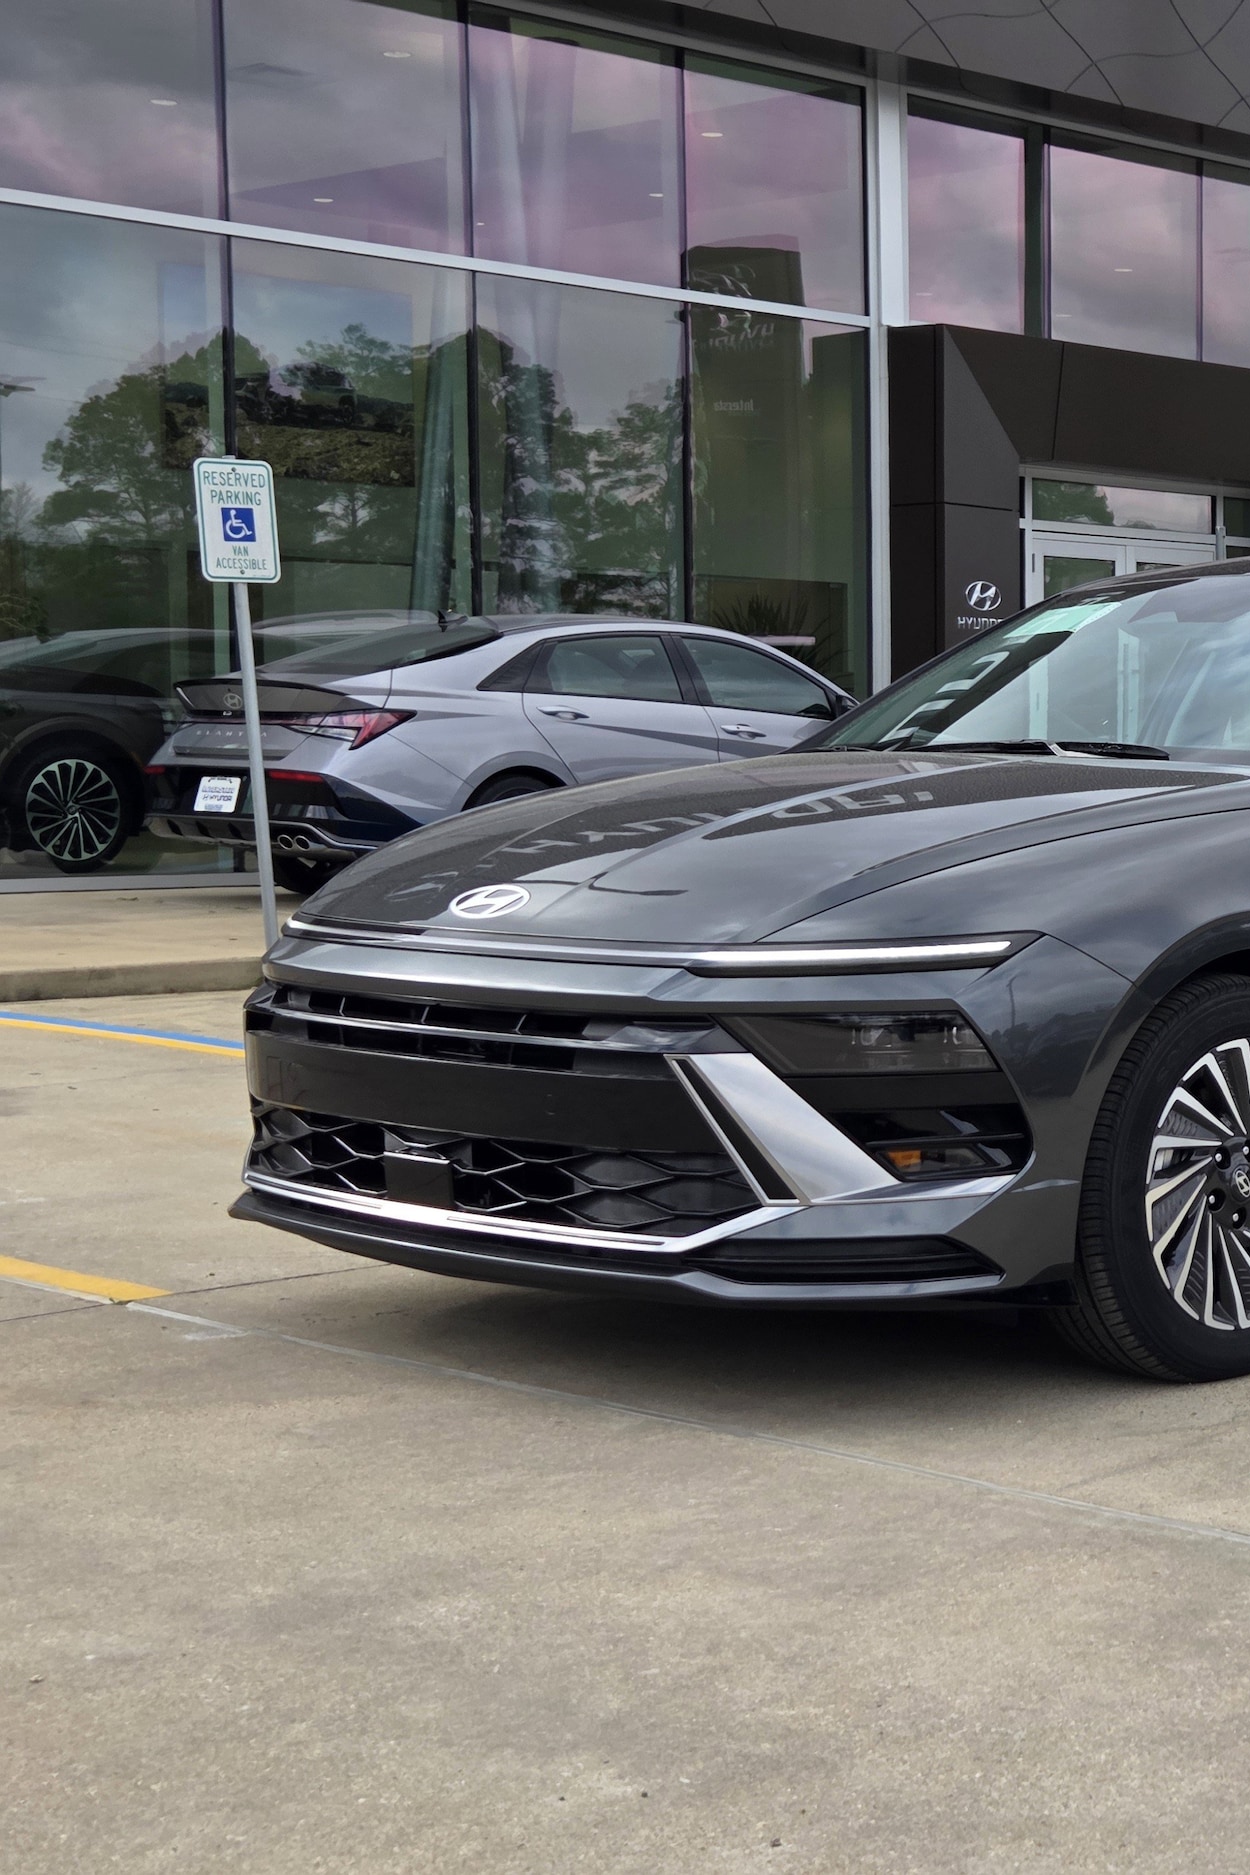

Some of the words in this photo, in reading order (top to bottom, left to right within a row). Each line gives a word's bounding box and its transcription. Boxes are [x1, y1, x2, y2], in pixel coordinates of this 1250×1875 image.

[203, 470, 266, 488] RESERVED
[210, 489, 262, 506] PARKING
[232, 545, 249, 556] VAN
[216, 557, 267, 570] ACCESSIBLE
[957, 616, 1004, 630] HYUND
[196, 729, 267, 737] ELANTA
